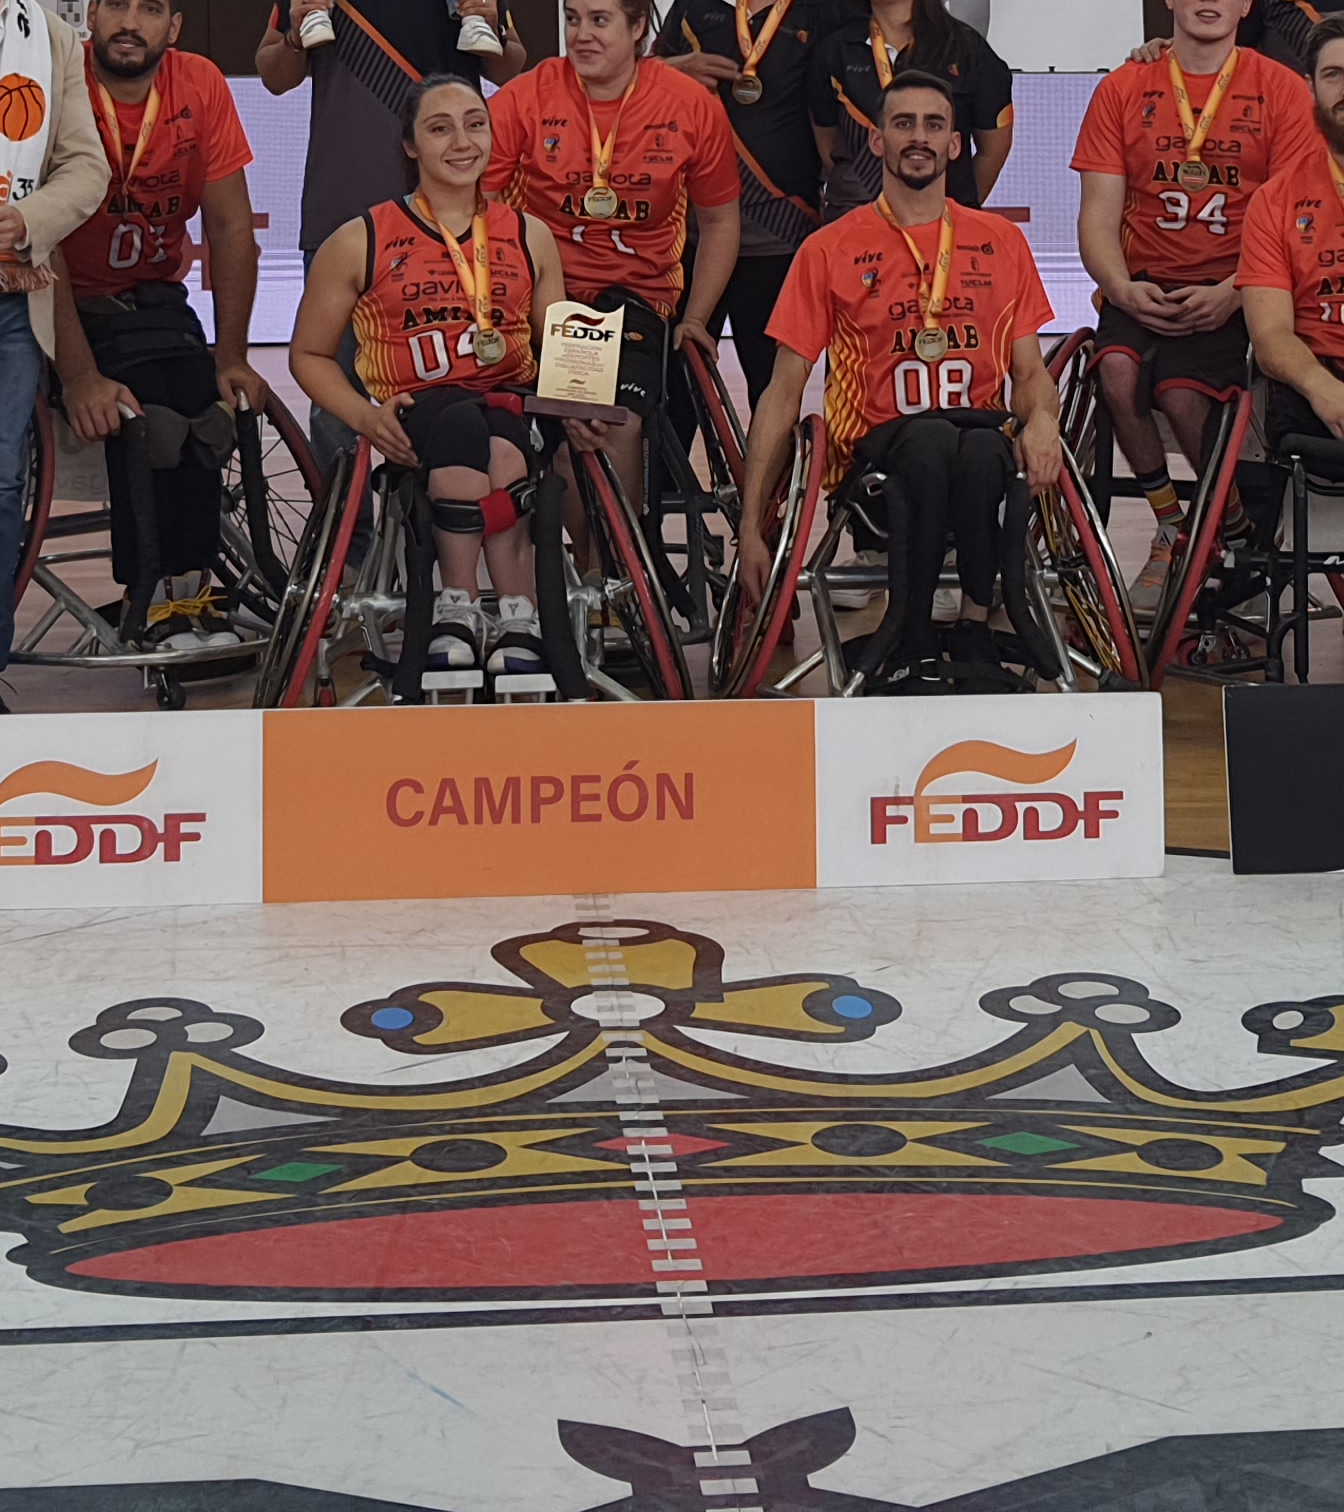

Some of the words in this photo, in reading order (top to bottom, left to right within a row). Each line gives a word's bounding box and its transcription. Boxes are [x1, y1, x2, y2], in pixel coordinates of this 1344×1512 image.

[565, 171, 652, 186] gaiota
[1152, 161, 1240, 187] AAB
[559, 194, 651, 222] AAB
[401, 279, 507, 302] gavia
[550, 324, 615, 342] FEDDF
[891, 325, 980, 355] AAB
[620, 383, 646, 397] vive
[894, 359, 974, 414] 08
[385, 759, 696, 828] CAMPEÓN
[870, 791, 1124, 845] FEDDF
